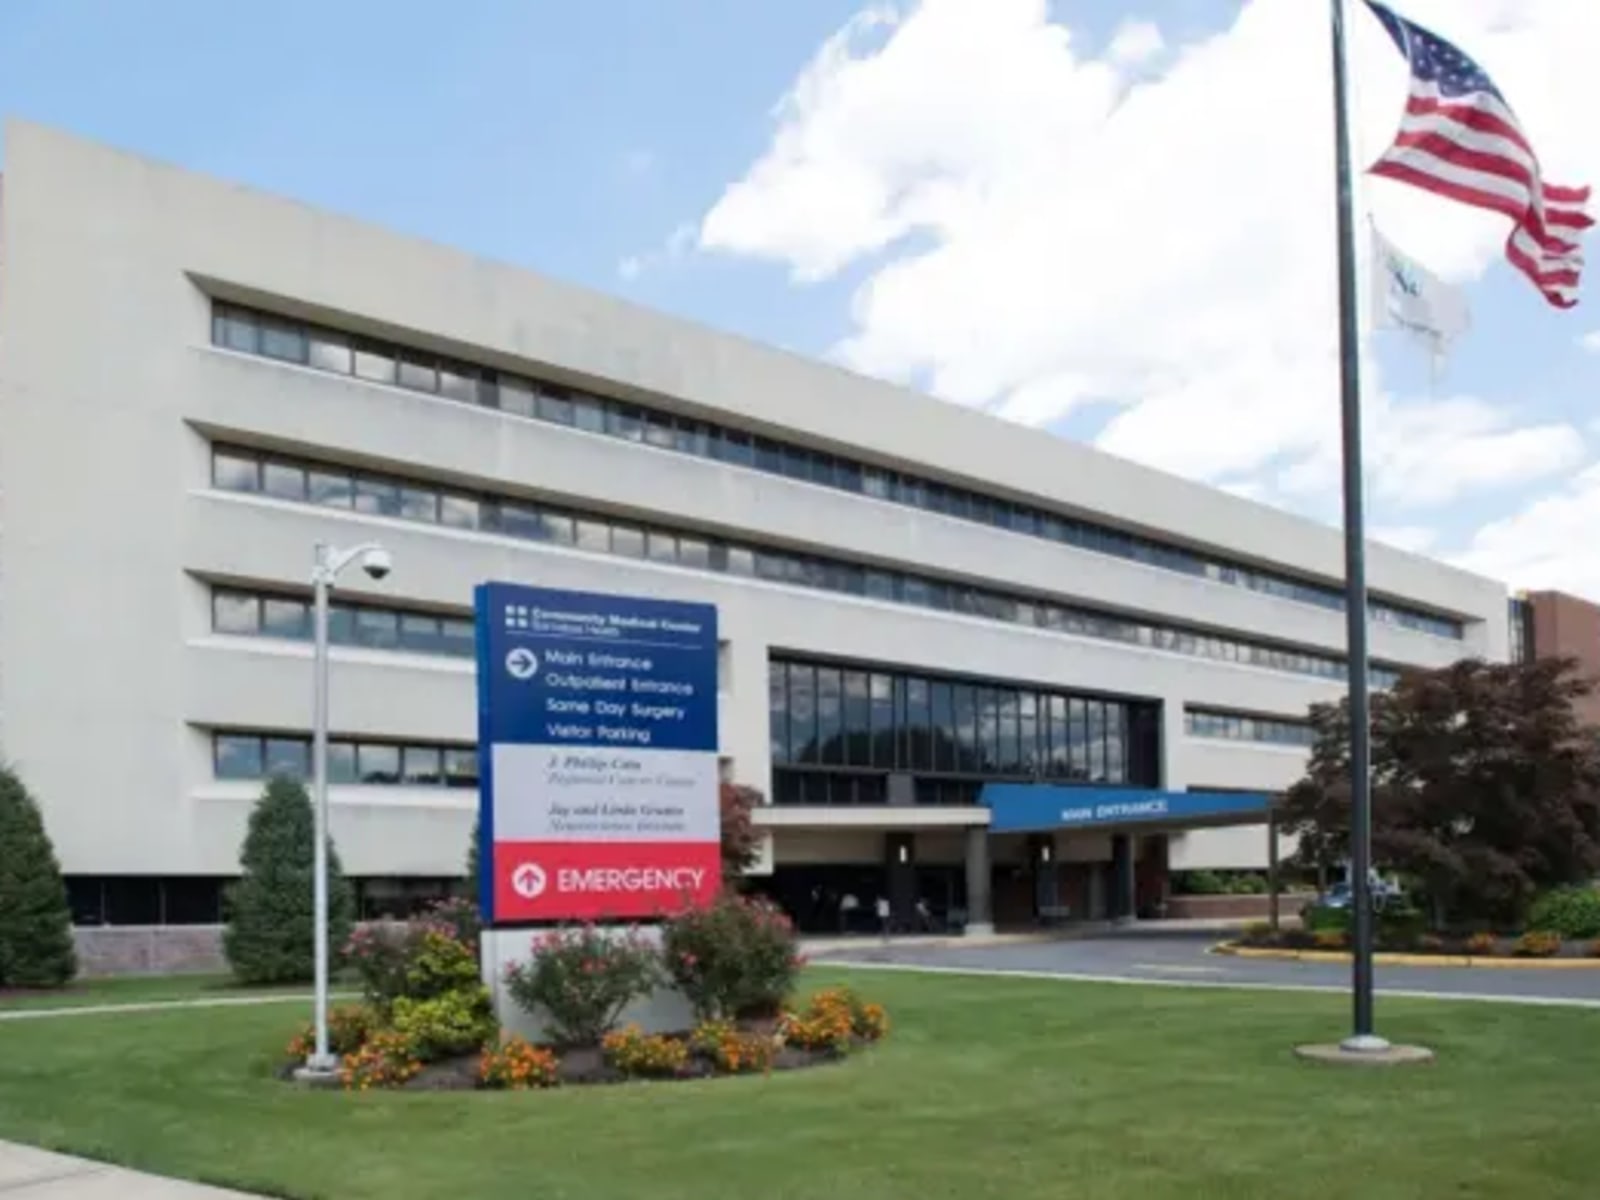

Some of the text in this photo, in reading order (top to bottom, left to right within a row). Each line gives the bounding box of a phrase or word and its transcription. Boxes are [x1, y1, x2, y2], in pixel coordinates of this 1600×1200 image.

[531, 607, 605, 626] Community
[609, 614, 657, 629] Medical
[545, 649, 653, 670] Main Entrance
[545, 673, 694, 695] Outpatient Entrance
[546, 698, 685, 720] Same Day Surgery
[547, 722, 651, 743] Visitor Parking
[548, 802, 570, 817] Jay
[573, 803, 599, 816] and
[1096, 800, 1168, 818] ENTRANCE
[557, 867, 705, 892] EMERGENCY
